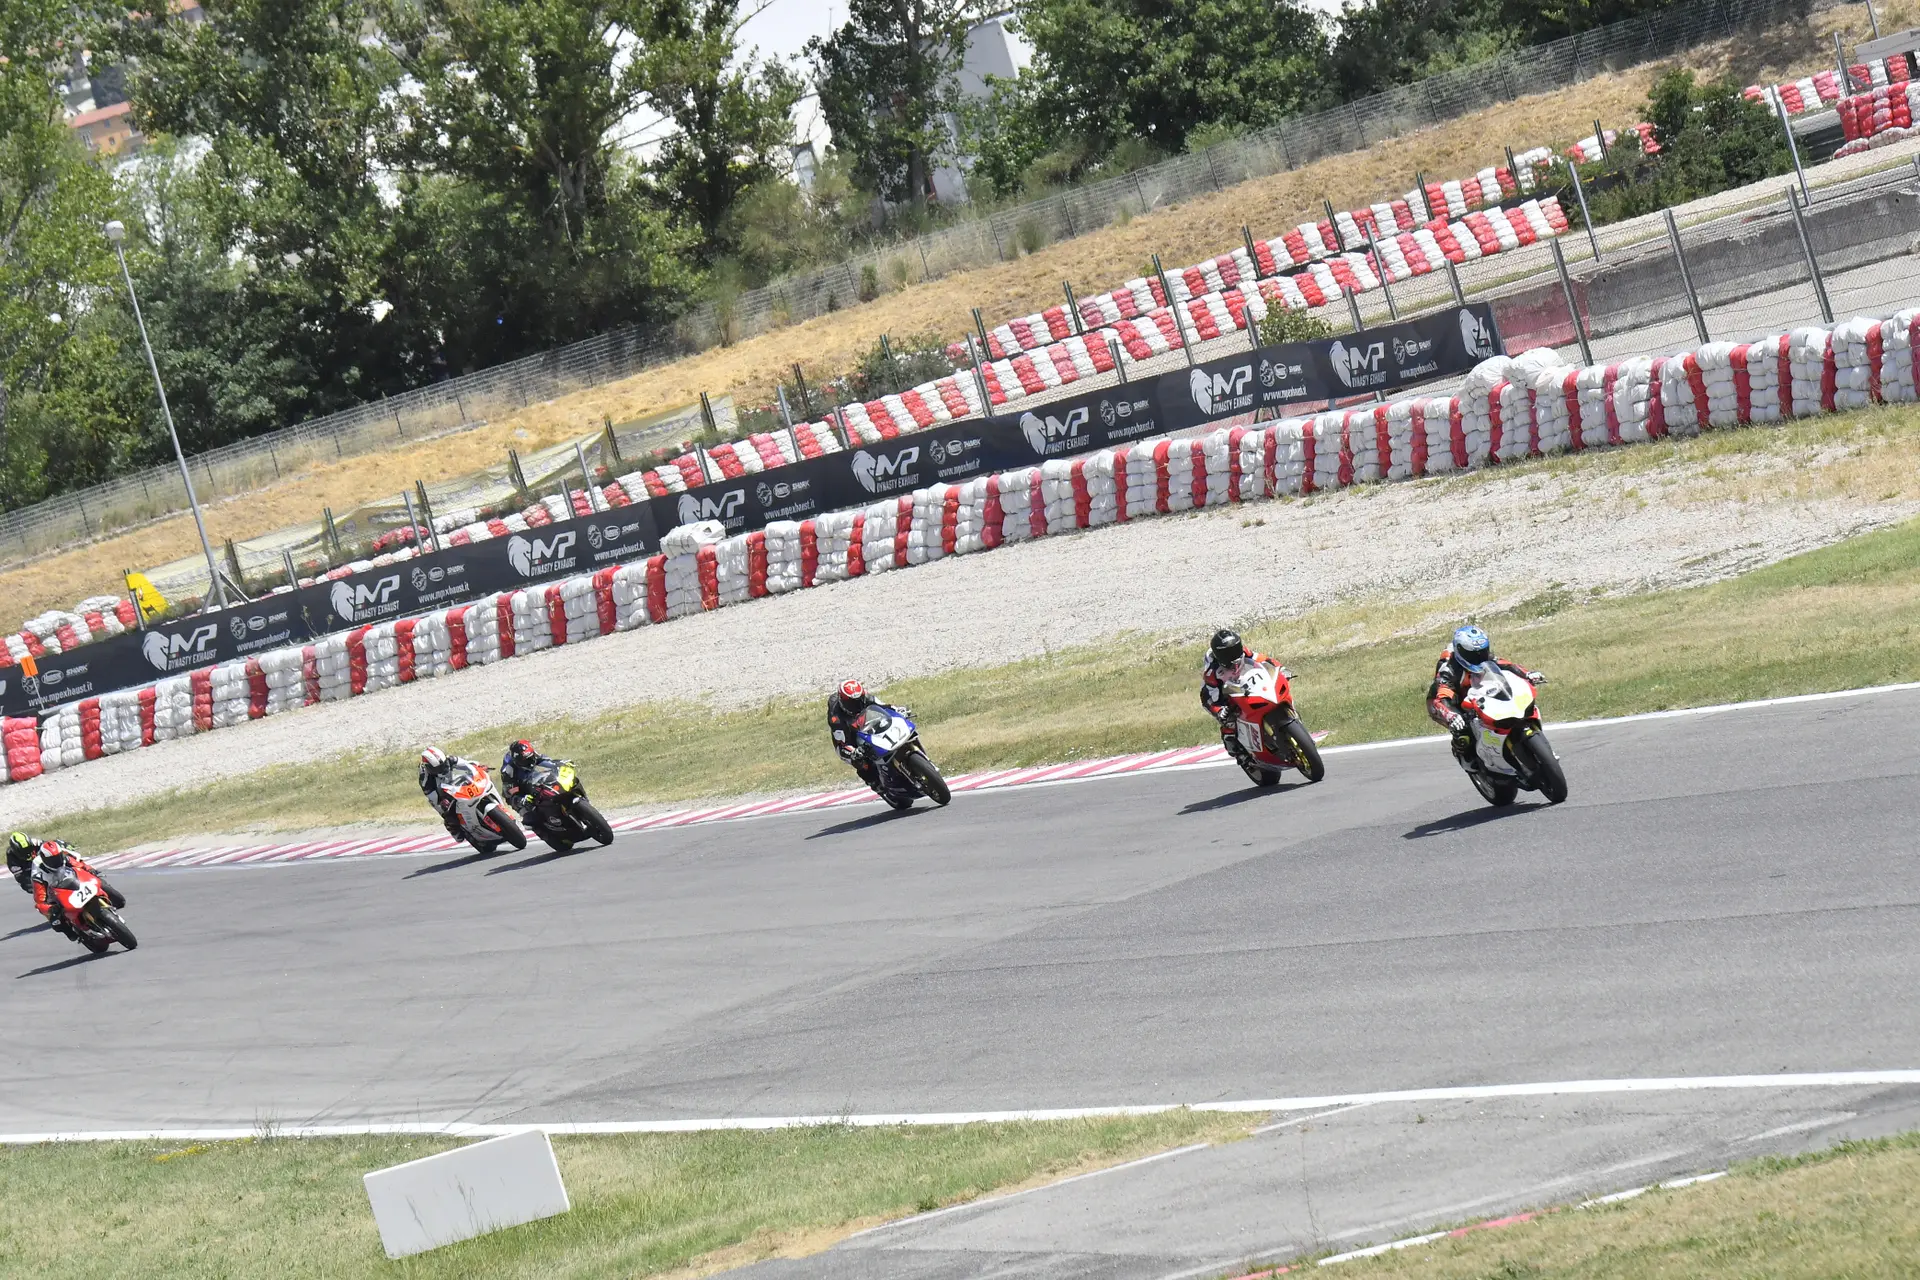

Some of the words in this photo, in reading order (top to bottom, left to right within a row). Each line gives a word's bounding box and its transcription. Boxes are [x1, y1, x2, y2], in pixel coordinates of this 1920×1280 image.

[1350, 341, 1385, 372] MP
[1212, 364, 1253, 396] MP
[1044, 406, 1090, 437] MP
[875, 446, 920, 476] MP
[701, 488, 745, 519] MP
[532, 530, 576, 560] MP
[355, 574, 400, 604] MP
[170, 623, 218, 654] MP
[77, 884, 93, 903] 24
